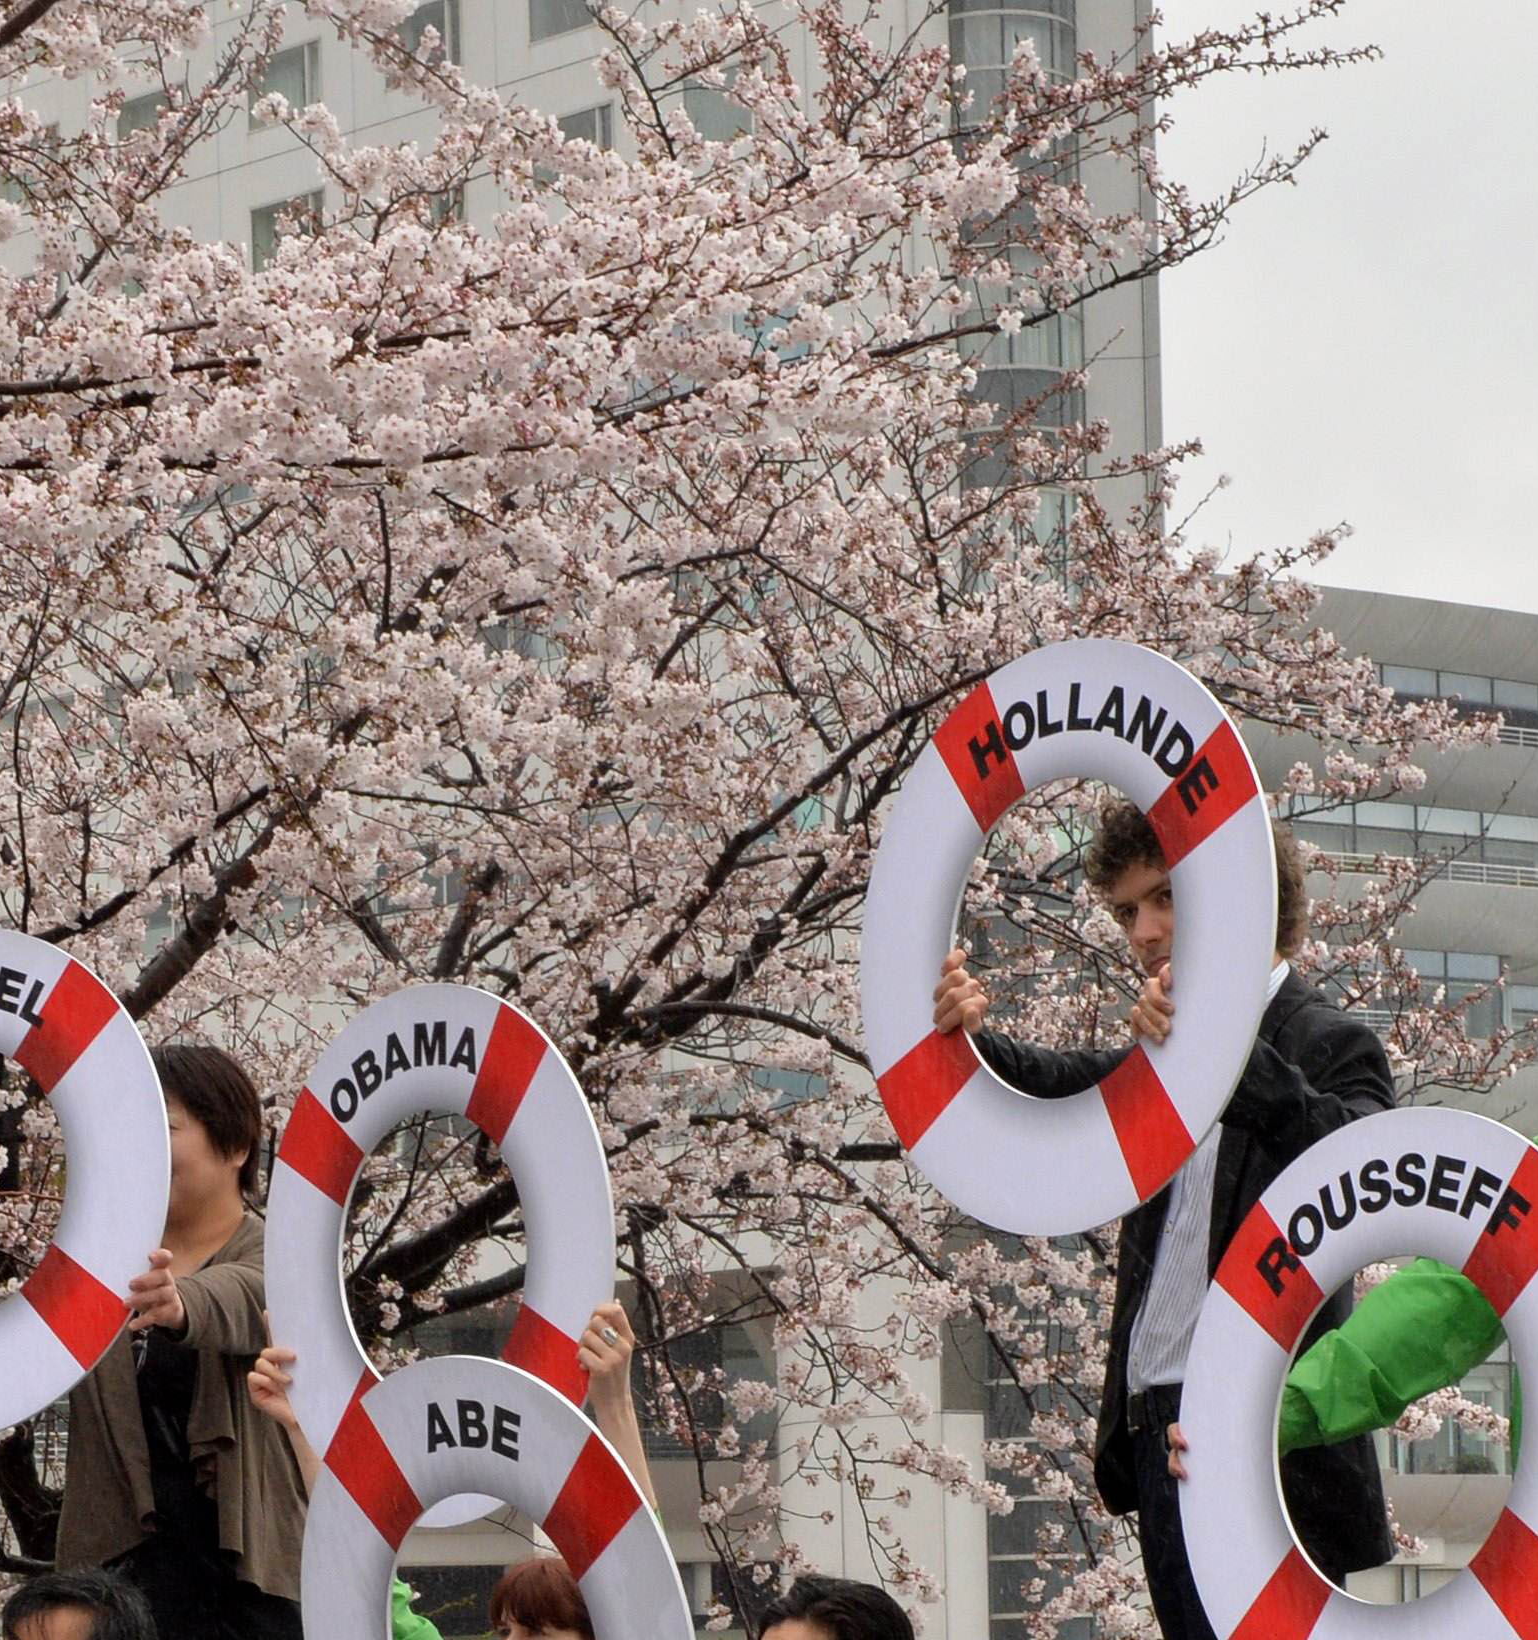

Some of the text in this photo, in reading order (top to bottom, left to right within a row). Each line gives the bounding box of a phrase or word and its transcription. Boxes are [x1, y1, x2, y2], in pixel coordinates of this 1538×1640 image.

[967, 683, 1220, 815] HOLLANDE
[330, 1021, 477, 1123] OBAMA
[1256, 1153, 1531, 1297] ROUSSEFF
[427, 1399, 522, 1462] ABE
